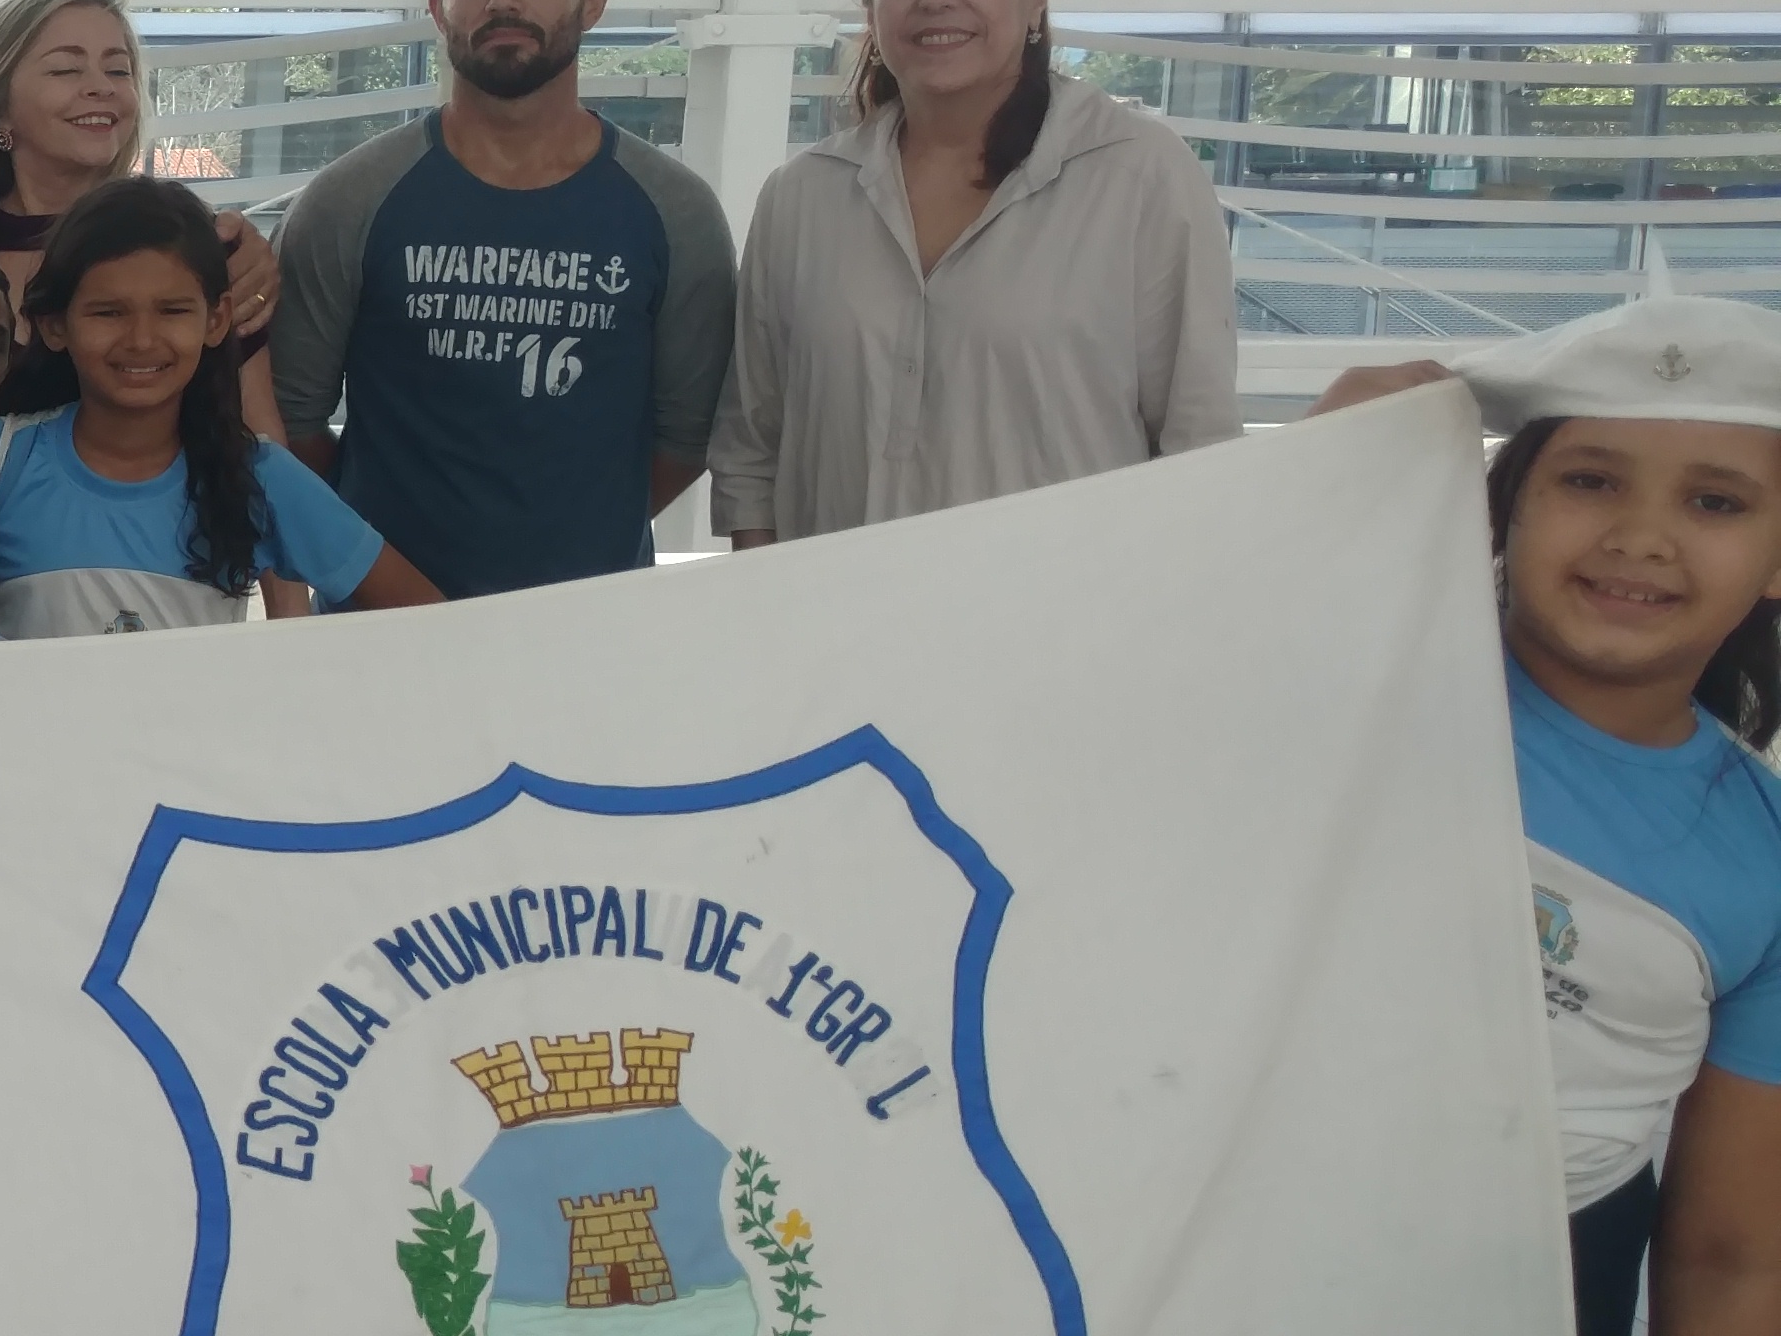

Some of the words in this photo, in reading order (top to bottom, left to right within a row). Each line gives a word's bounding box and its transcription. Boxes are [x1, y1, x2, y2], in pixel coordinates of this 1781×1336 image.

[404, 245, 593, 291] WARFACE
[405, 293, 449, 319] 1ST
[454, 294, 564, 326] MARINE
[568, 301, 617, 330] DIV.
[515, 333, 583, 398] 16
[236, 982, 390, 1182] ESCOLA
[372, 885, 664, 1001] MUNICIPAL
[683, 898, 763, 985] DE
